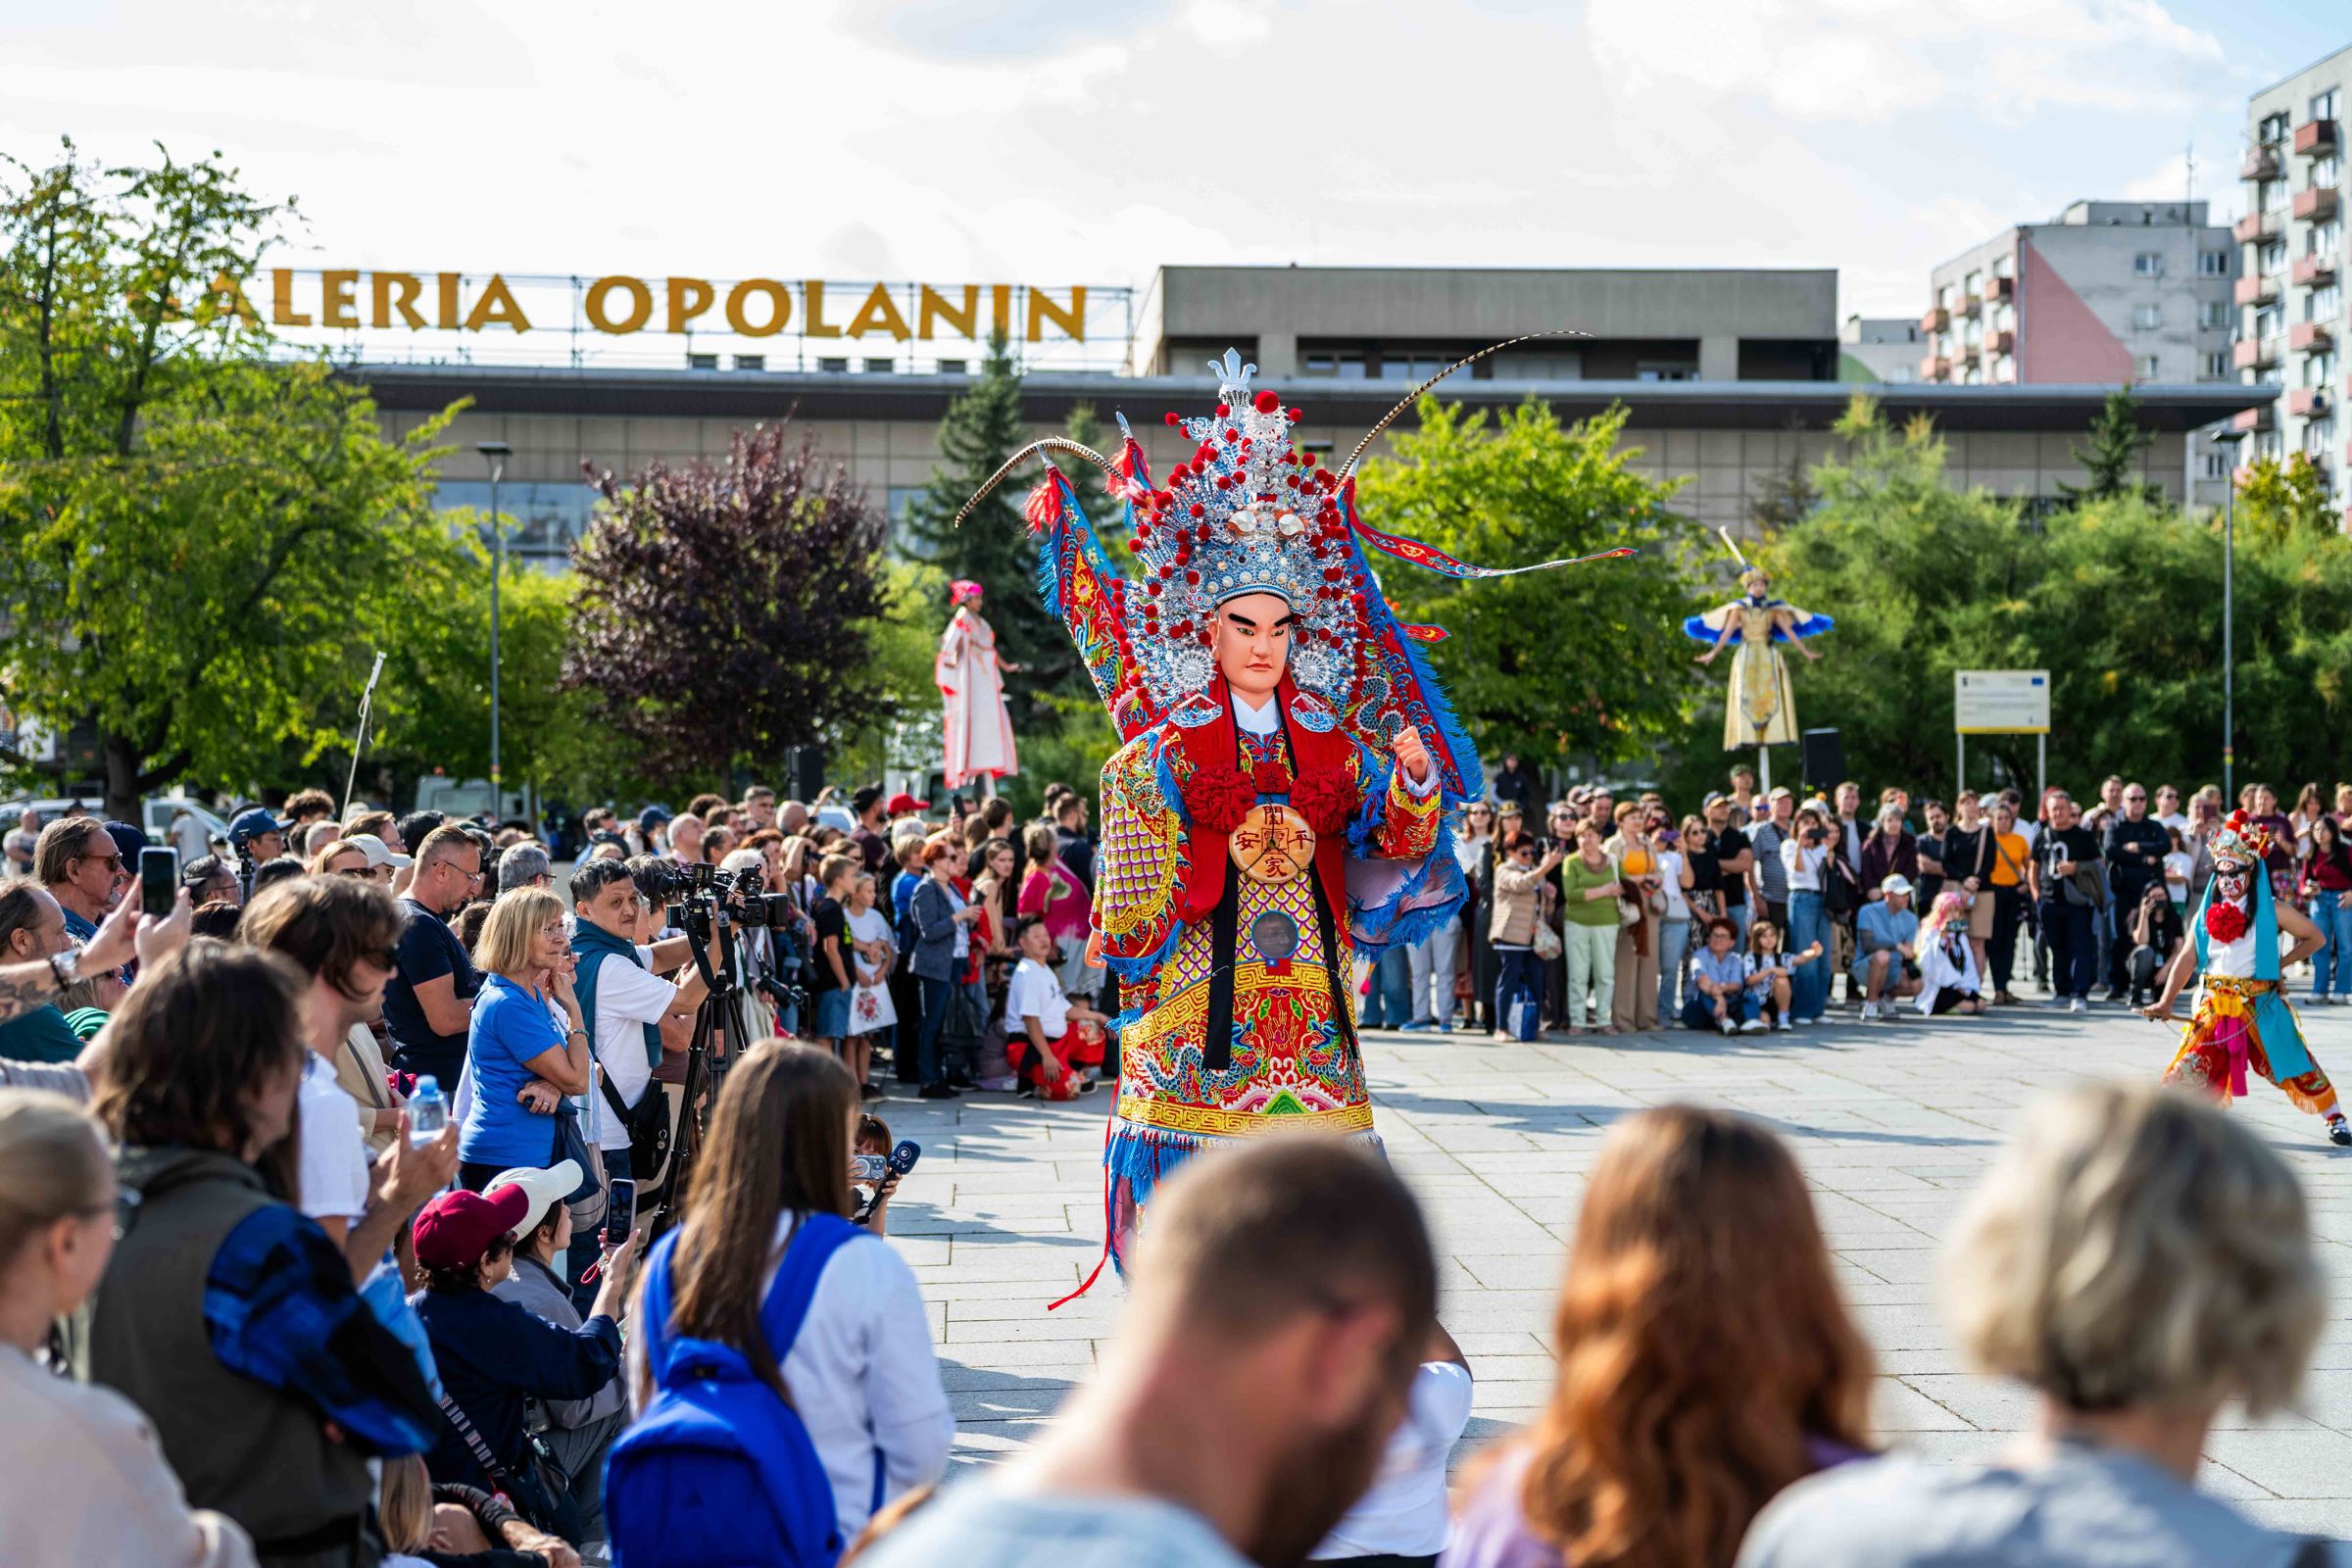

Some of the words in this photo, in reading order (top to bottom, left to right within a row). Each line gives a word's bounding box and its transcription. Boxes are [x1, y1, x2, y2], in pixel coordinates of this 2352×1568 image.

[585, 275, 1087, 343] OPOLANIN
[1235, 830, 1261, 851] 安
[1288, 830, 1314, 850] 平
[1264, 857, 1288, 878] 家
[890, 1155, 907, 1169] FTV
